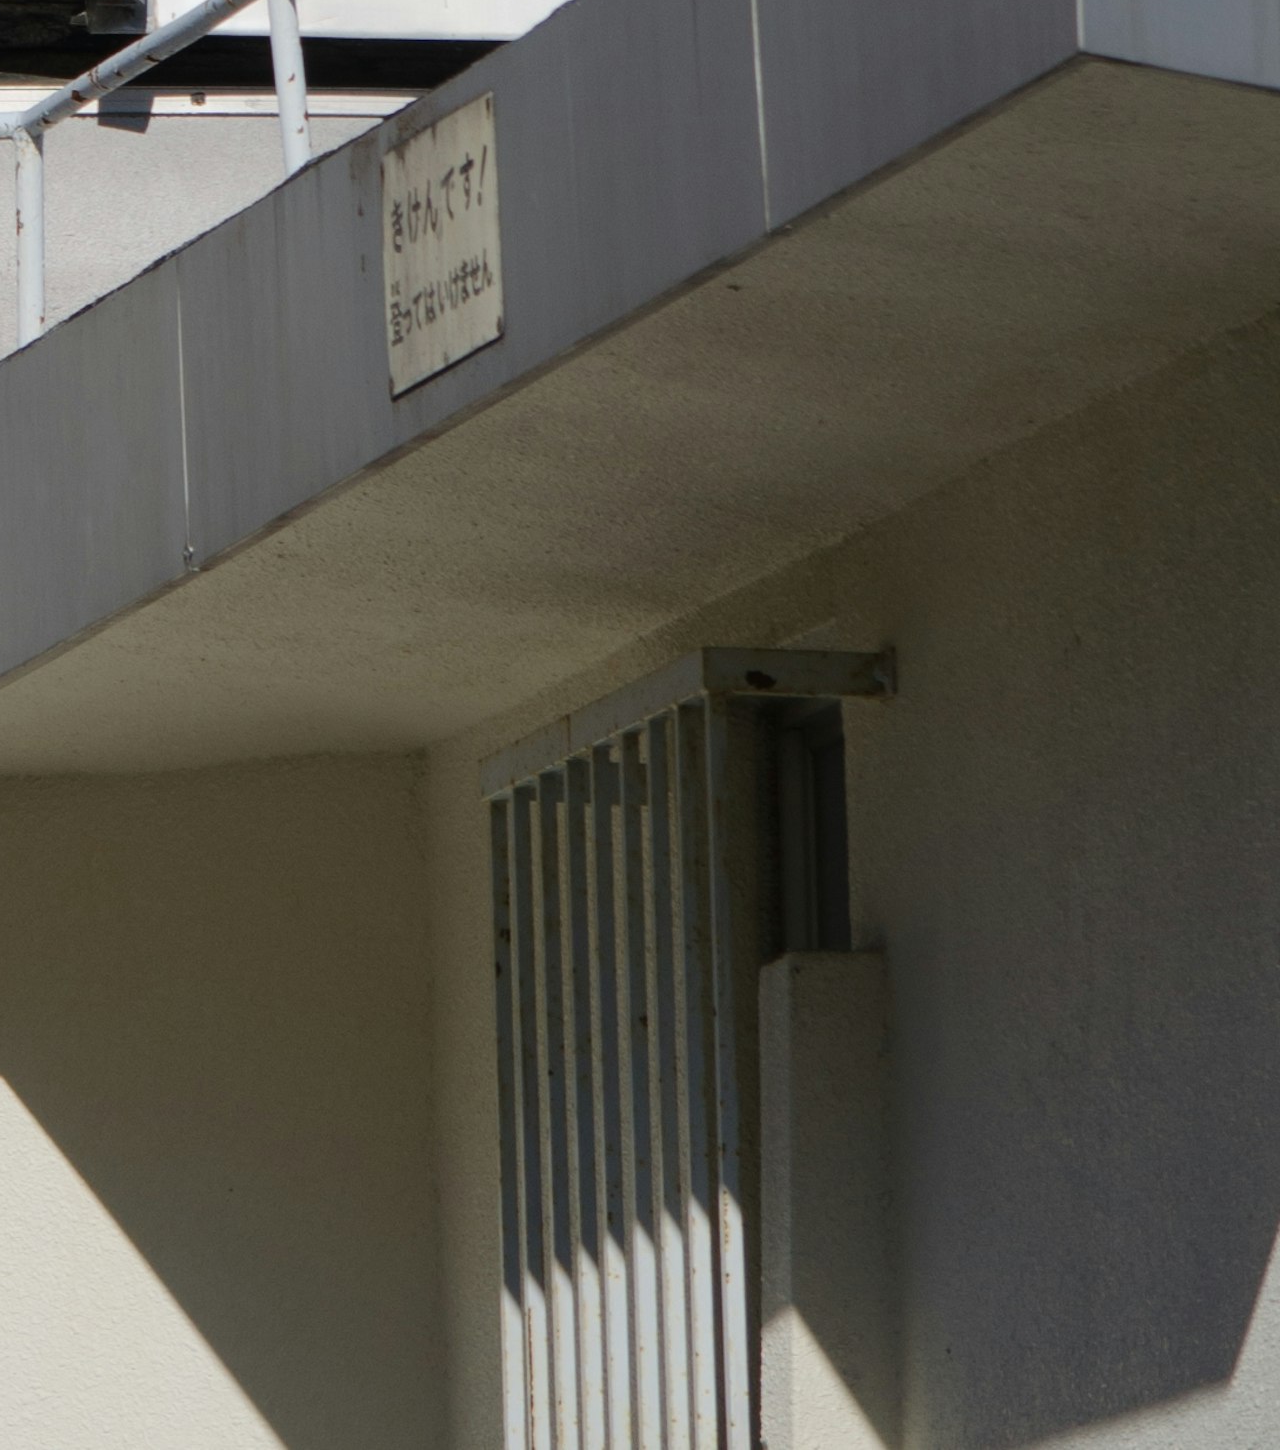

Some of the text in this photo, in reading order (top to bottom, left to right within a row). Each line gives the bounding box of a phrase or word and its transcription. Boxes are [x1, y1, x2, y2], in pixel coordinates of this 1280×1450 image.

[392, 145, 488, 253] きけんです!
